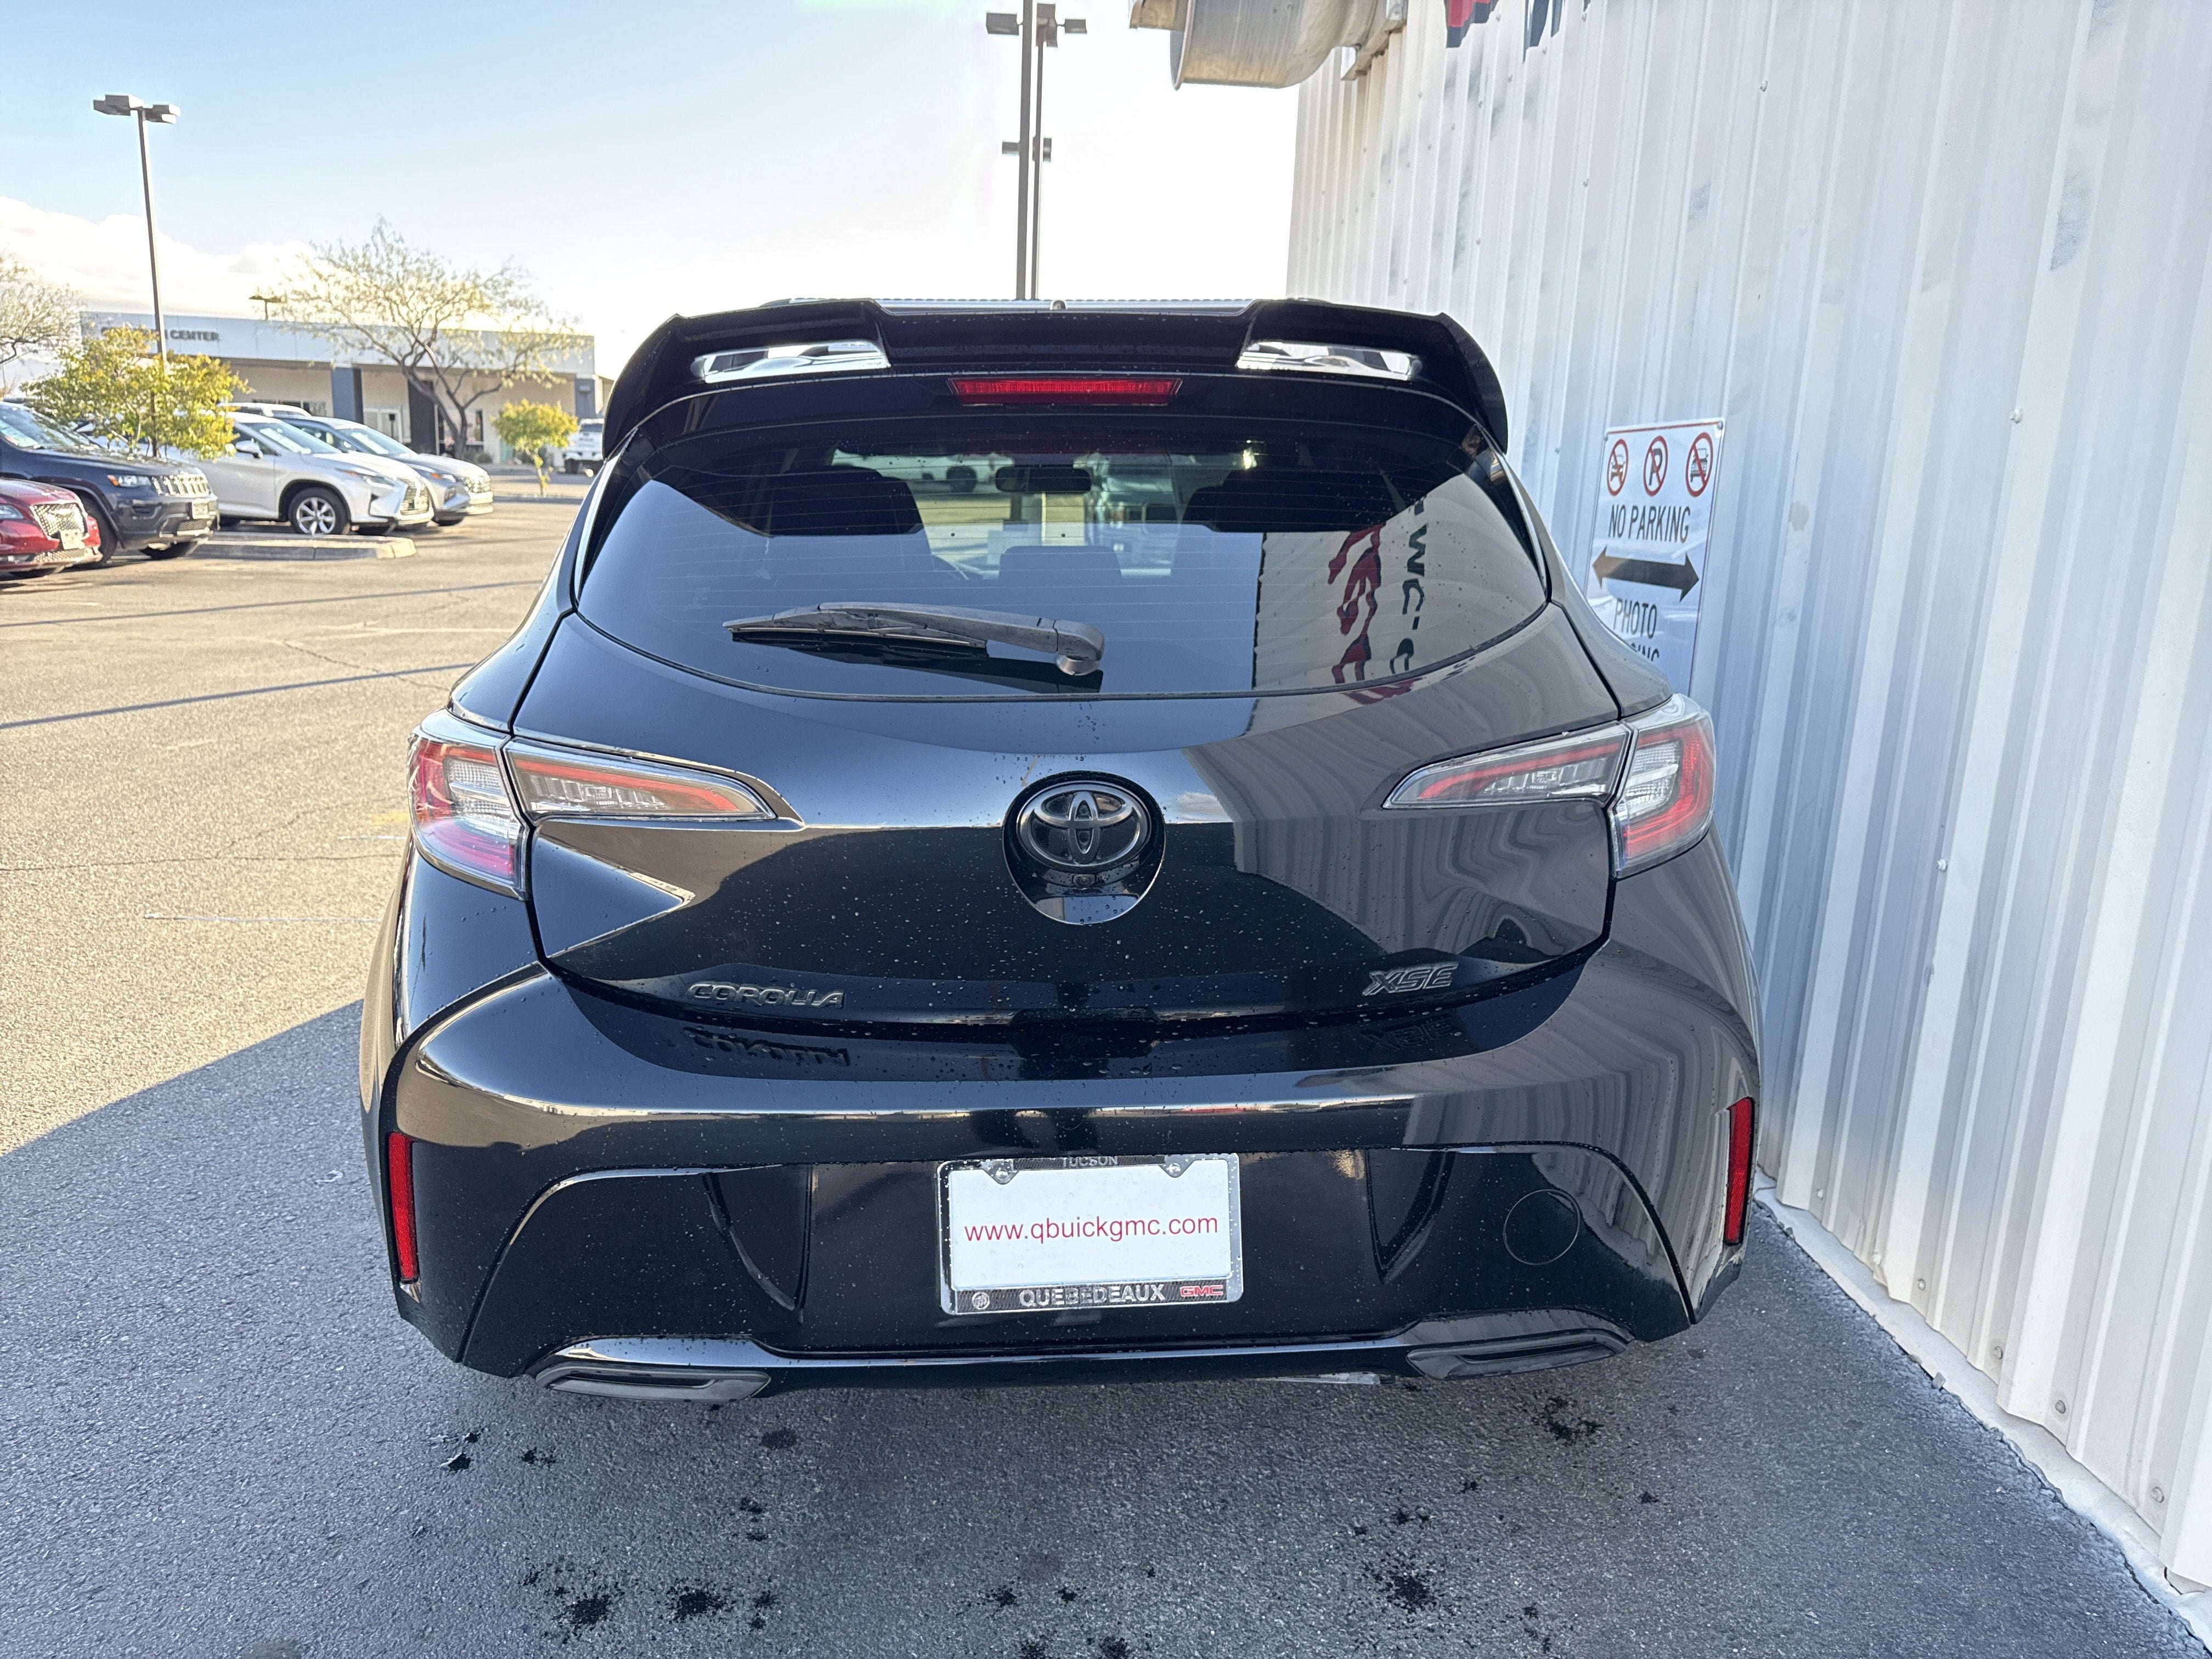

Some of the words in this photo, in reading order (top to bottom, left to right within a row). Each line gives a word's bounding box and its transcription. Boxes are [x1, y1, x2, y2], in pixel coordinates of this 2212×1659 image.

[170, 329, 219, 341] CENTER
[1608, 504, 1626, 538] NO
[1628, 505, 1691, 543] PARKING
[1613, 597, 1657, 639] PHOTO
[1362, 961, 1459, 996] XSE
[687, 981, 846, 1009] COROLLA
[1062, 1156, 1118, 1169] TUCSON
[964, 1216, 1218, 1244] www.qbuickgmc.com
[1019, 1284, 1166, 1307] QUEBEDEAUX
[1180, 1284, 1224, 1297] GMC
